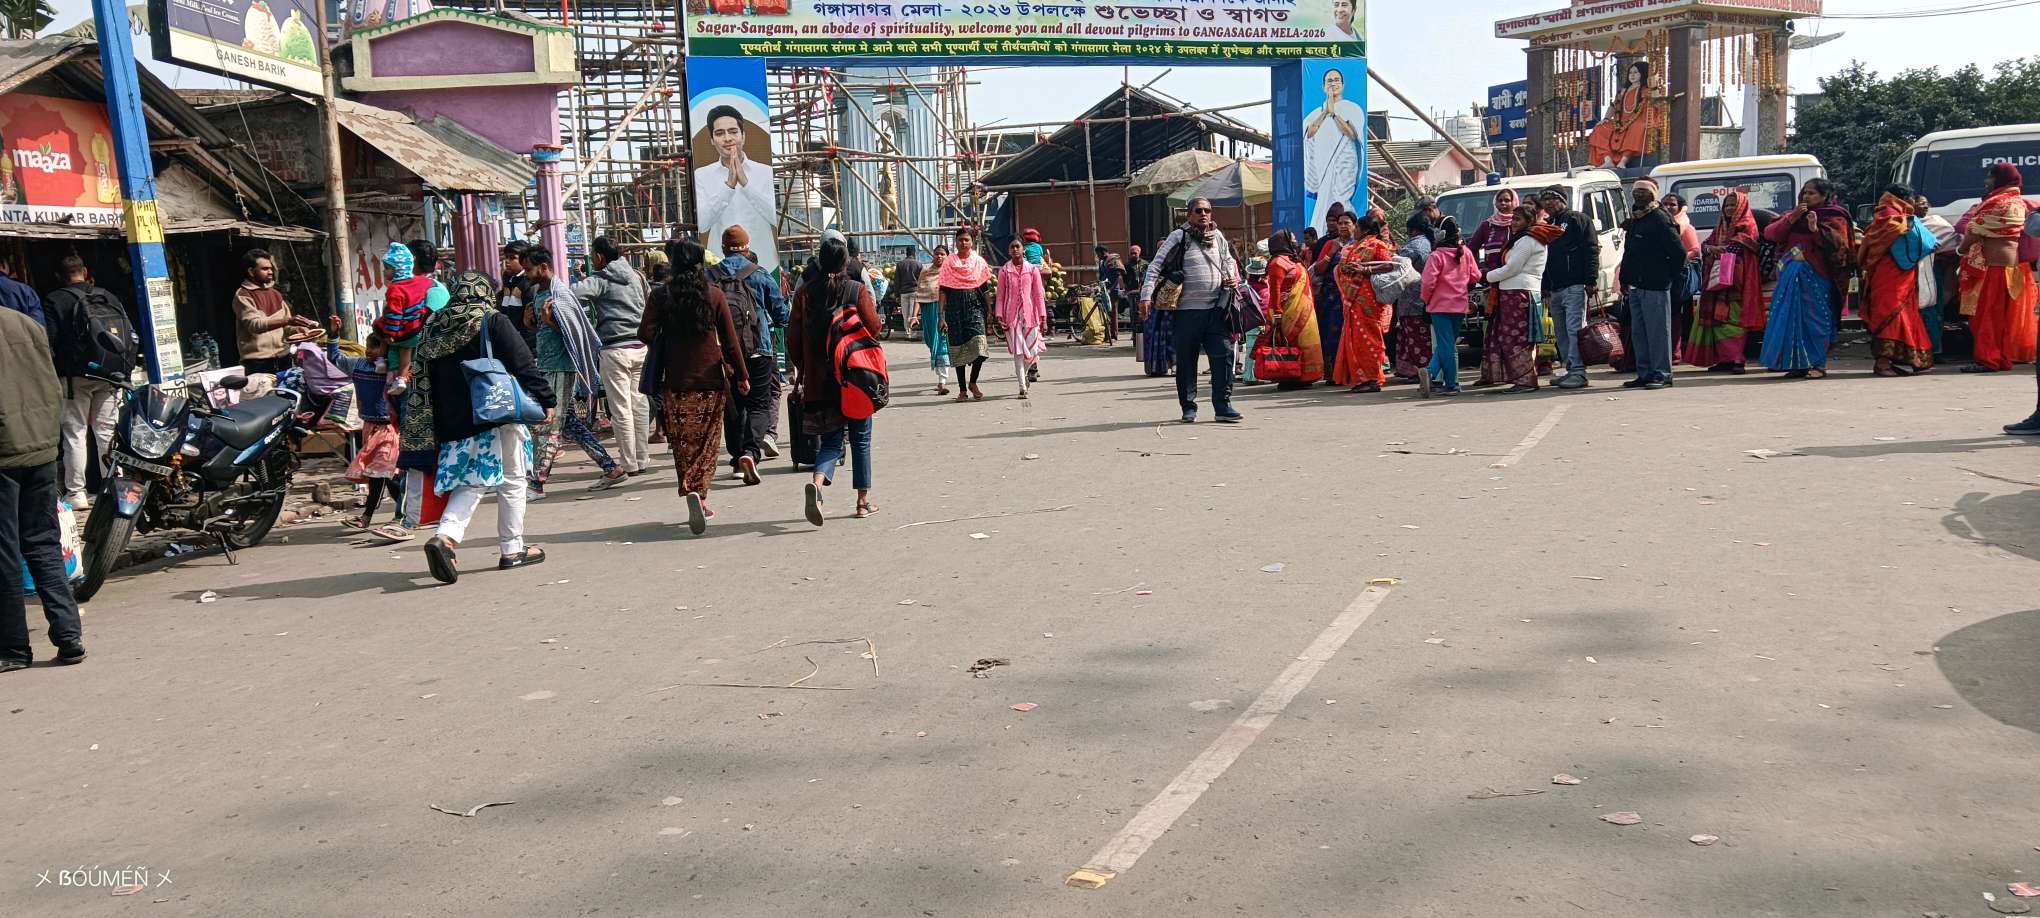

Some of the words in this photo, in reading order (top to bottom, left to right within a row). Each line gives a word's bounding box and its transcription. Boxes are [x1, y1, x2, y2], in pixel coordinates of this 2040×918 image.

[813, 3, 892, 17] গঙ্গাসাগর
[960, 3, 1010, 17] ২০২৬
[1016, 1, 1086, 18] উপলক্ষে
[1095, 5, 1187, 23] শুভেচ্ছা
[1197, 8, 1215, 21] ও
[1223, 6, 1290, 23] স্বাগত
[696, 20, 799, 36] Sagar-Sangam,
[802, 25, 818, 34] an
[822, 22, 859, 34] abode
[863, 22, 876, 36] of
[880, 22, 955, 36] spirituality,
[958, 22, 1011, 35] welcome
[1015, 25, 1037, 35] you
[1042, 23, 1063, 34] and
[1066, 23, 1081, 34] all
[1085, 23, 1124, 35] devout
[1128, 24, 1175, 38] pilgrims
[1179, 25, 1190, 36] to
[1193, 26, 1269, 38] GANGASAGAR
[1270, 27, 1326, 38] MELA-2026
[785, 41, 828, 53] गंगासागर
[831, 41, 856, 53] संगम
[873, 41, 893, 53] आने
[1054, 41, 1068, 53] को
[1071, 41, 1109, 53] गंगासागर
[1112, 42, 1132, 53] मेला
[1164, 42, 1173, 54] के
[1256, 44, 1273, 56] और
[216, 49, 256, 71] GANESH
[258, 61, 287, 77] BARIK
[13, 148, 72, 173] maaza
[1981, 155, 2040, 168] POLIC
